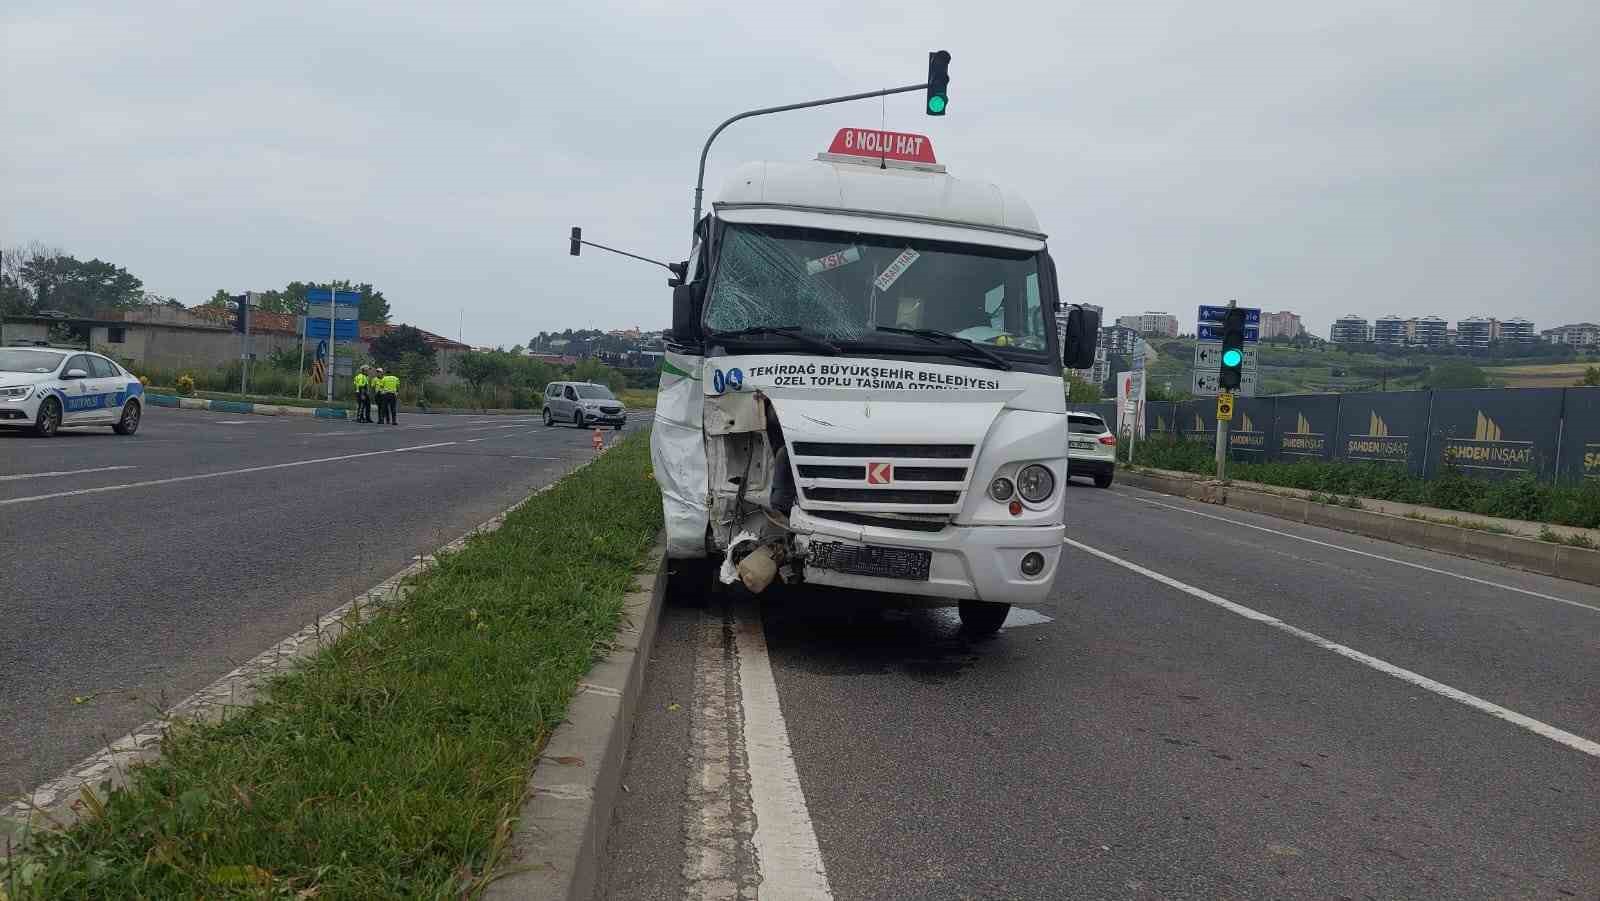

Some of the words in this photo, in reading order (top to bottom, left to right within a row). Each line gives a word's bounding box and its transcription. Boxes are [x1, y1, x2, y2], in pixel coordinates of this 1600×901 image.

[845, 130, 854, 148] 8
[857, 132, 892, 153] NOLU
[896, 135, 922, 155] HAT
[749, 363, 816, 377] TEKİRDAĞ
[820, 363, 914, 381] BÜYÜKŞEHİR
[919, 371, 999, 389] BELEDİYESİ
[811, 376, 851, 386] TOPLU
